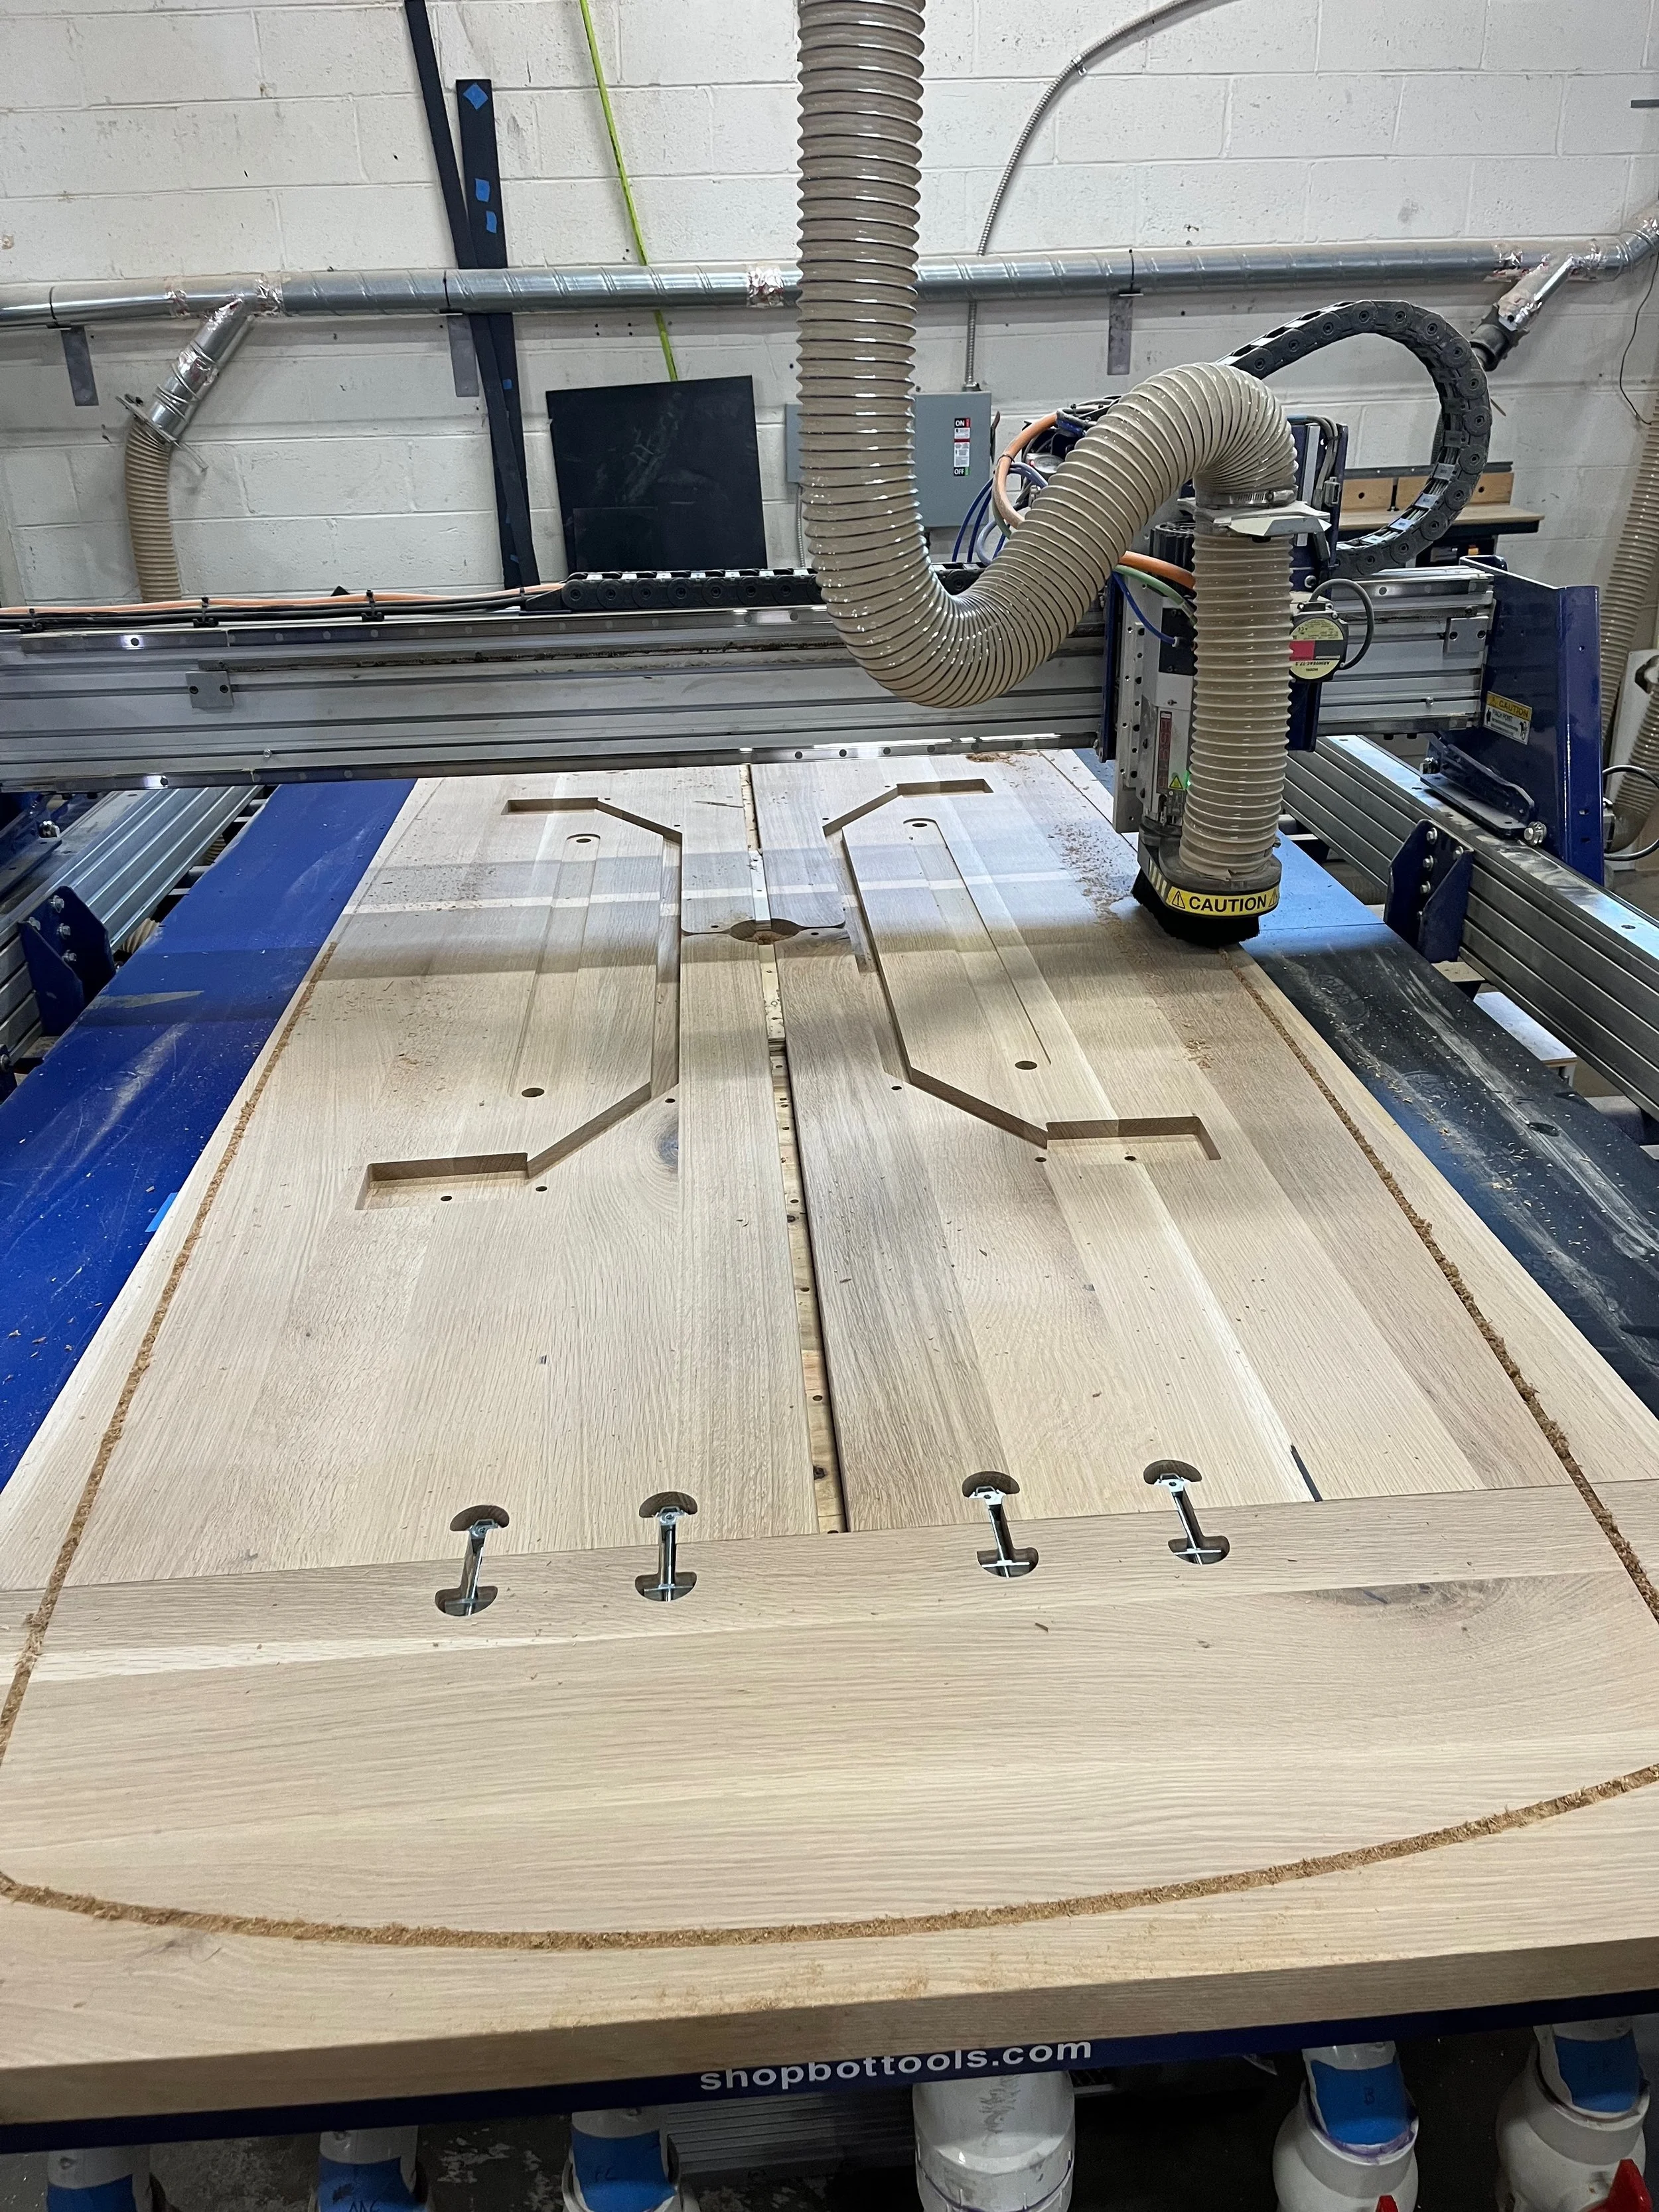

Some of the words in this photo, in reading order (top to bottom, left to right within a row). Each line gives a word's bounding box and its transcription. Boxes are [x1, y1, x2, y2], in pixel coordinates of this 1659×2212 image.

[1498, 700, 1528, 717] CAUTION
[1189, 894, 1267, 913] CAUTION
[700, 2040, 1092, 2091] shopbottools.com
